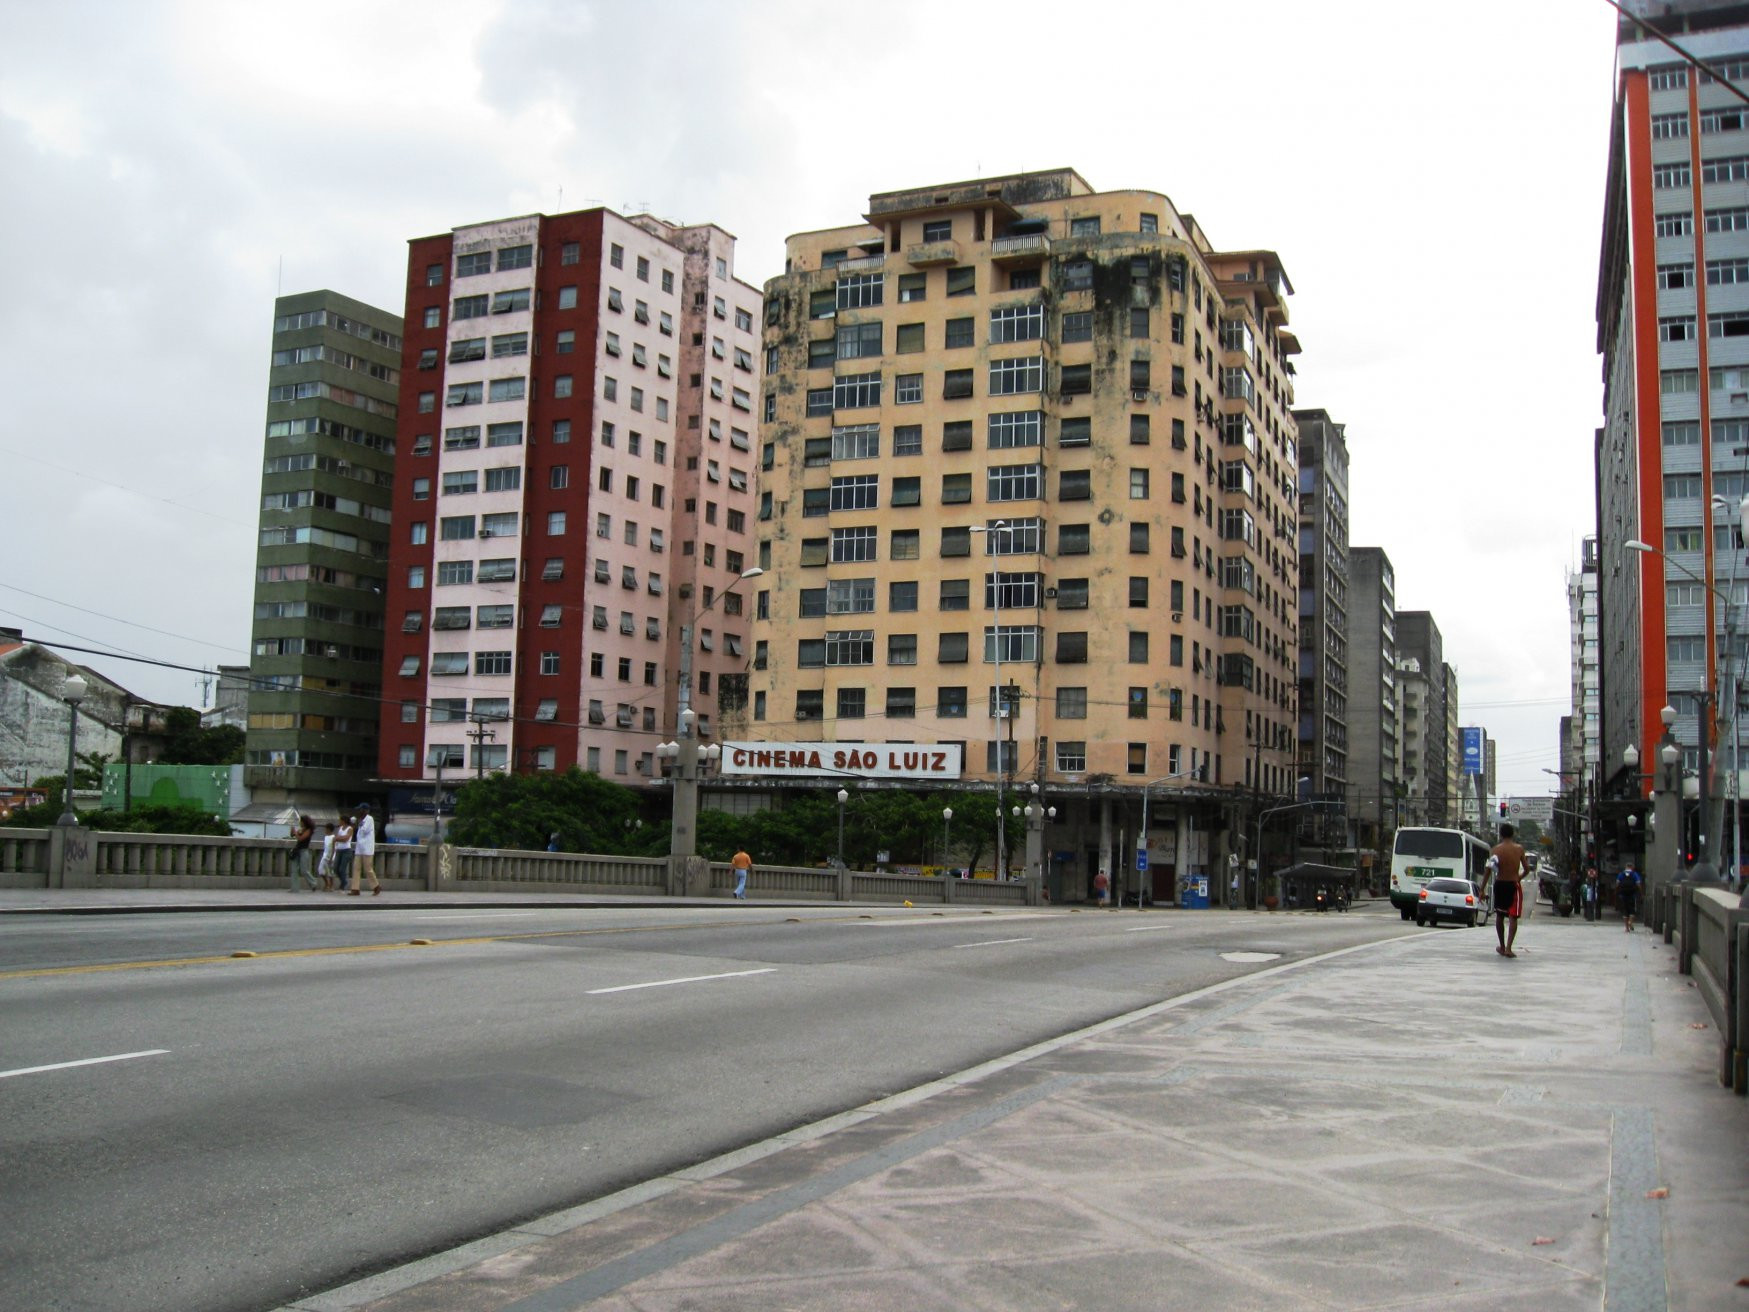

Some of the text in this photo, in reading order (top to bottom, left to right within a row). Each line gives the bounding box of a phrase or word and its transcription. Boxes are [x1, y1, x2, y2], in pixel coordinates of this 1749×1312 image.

[732, 748, 946, 771] CINEMA SÃO LUIZ
[1421, 868, 1435, 876] 721
